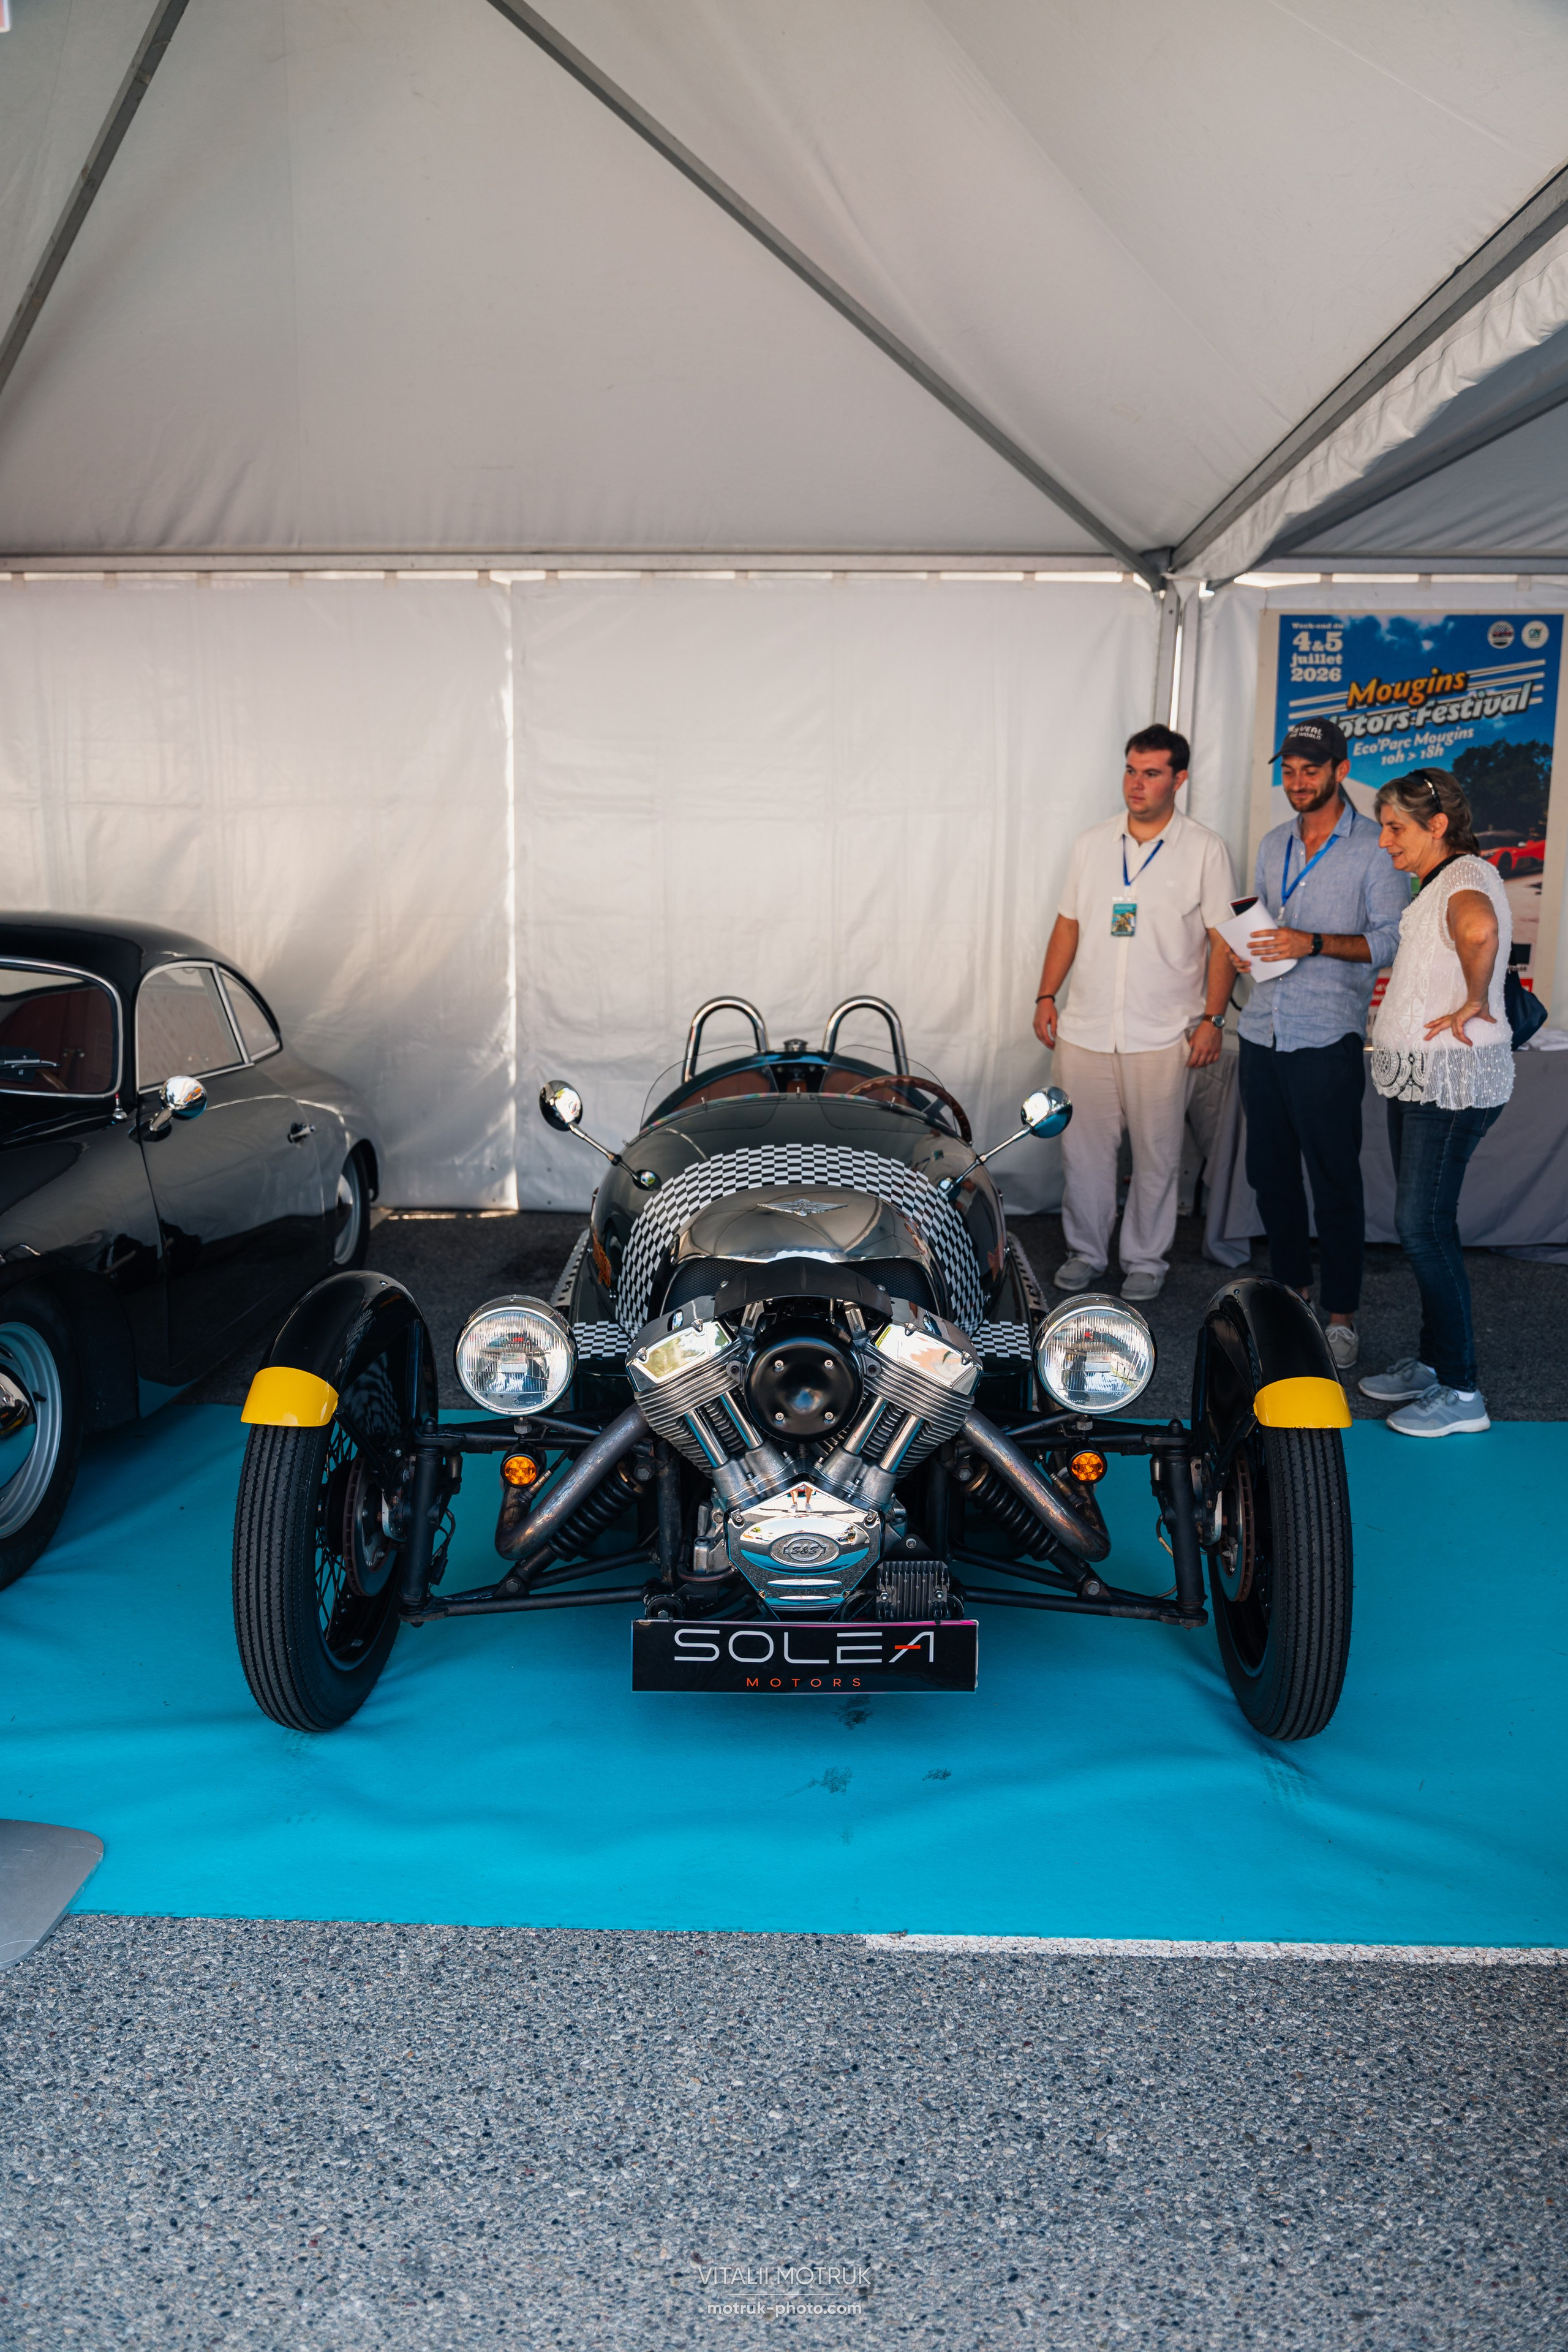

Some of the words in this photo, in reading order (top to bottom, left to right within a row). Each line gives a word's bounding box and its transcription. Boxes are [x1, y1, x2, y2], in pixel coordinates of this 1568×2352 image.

[1292, 631, 1343, 652] 4&5
[1290, 653, 1343, 668] juillet
[1291, 668, 1341, 682] 2026
[1347, 667, 1466, 707] Mougins
[1329, 710, 1410, 738] otors
[1415, 680, 1531, 726] Festival
[1414, 725, 1474, 747] Mougins
[1381, 749, 1404, 766] 10h
[1420, 742, 1445, 760] 18h
[791, 1544, 820, 1555] S&S
[674, 1629, 934, 1664] SOLEA
[747, 1677, 861, 1687] MOTORS
